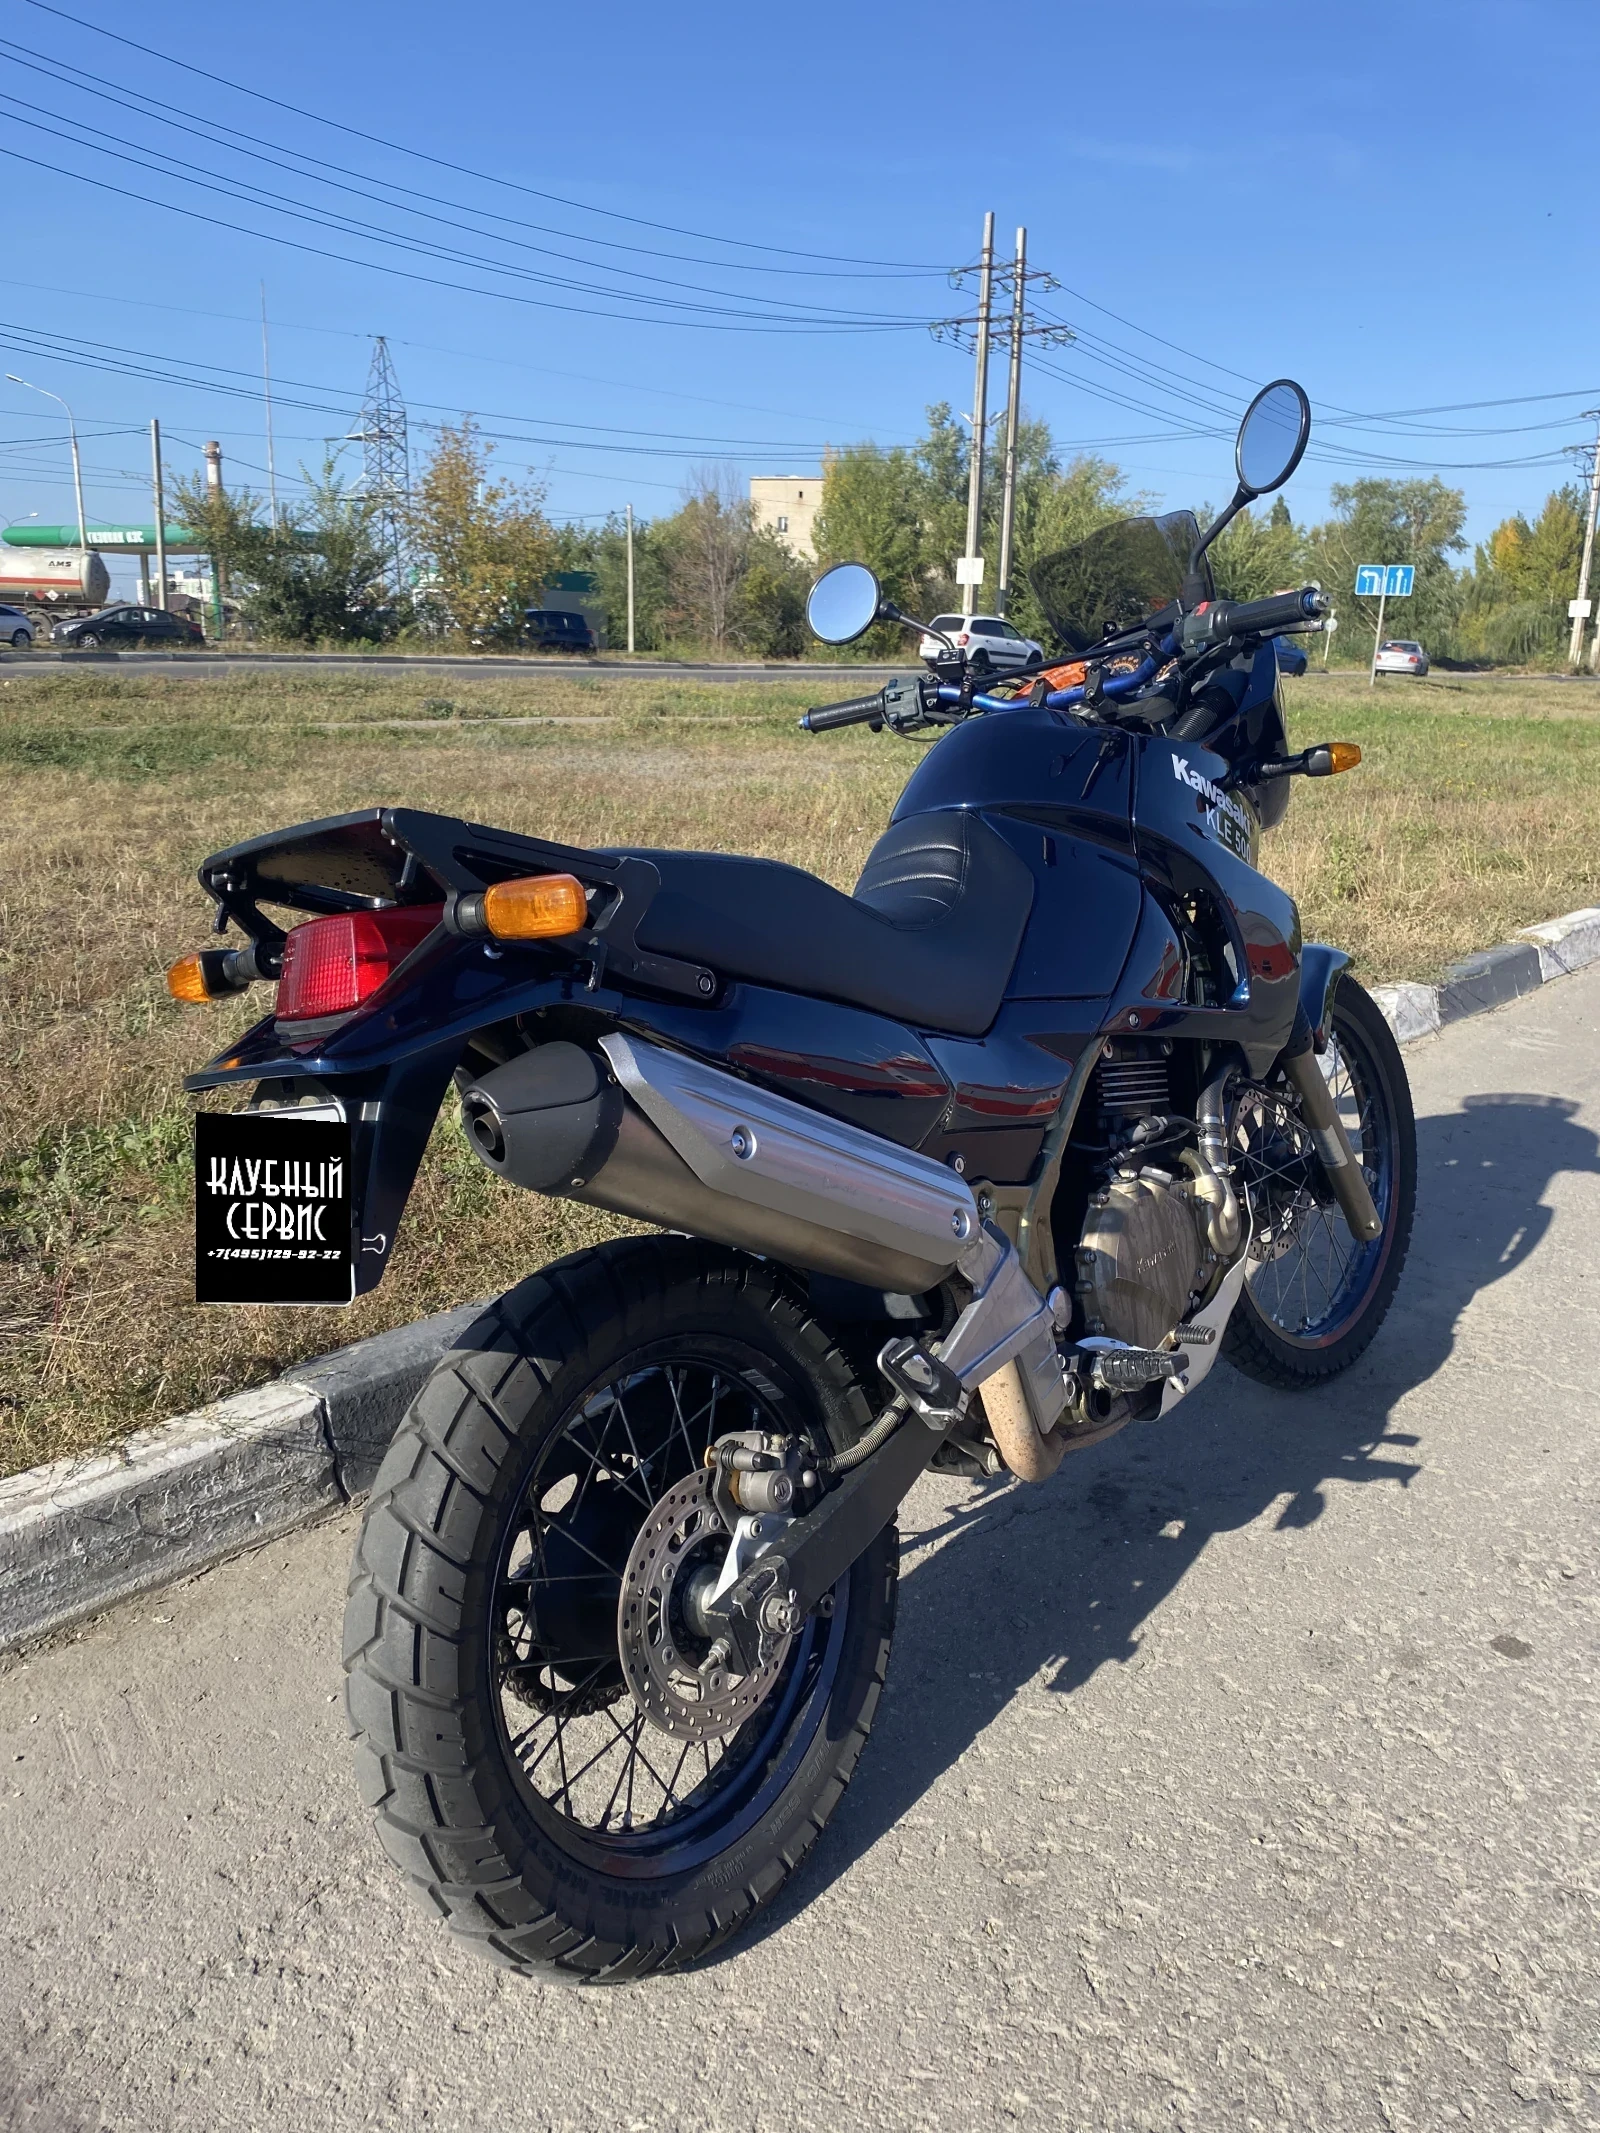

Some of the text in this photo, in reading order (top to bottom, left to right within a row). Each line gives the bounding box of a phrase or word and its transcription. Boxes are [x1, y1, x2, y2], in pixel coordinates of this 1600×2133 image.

[1171, 753, 1251, 838] Kawasaki
[1205, 803, 1251, 863] KLE 500
